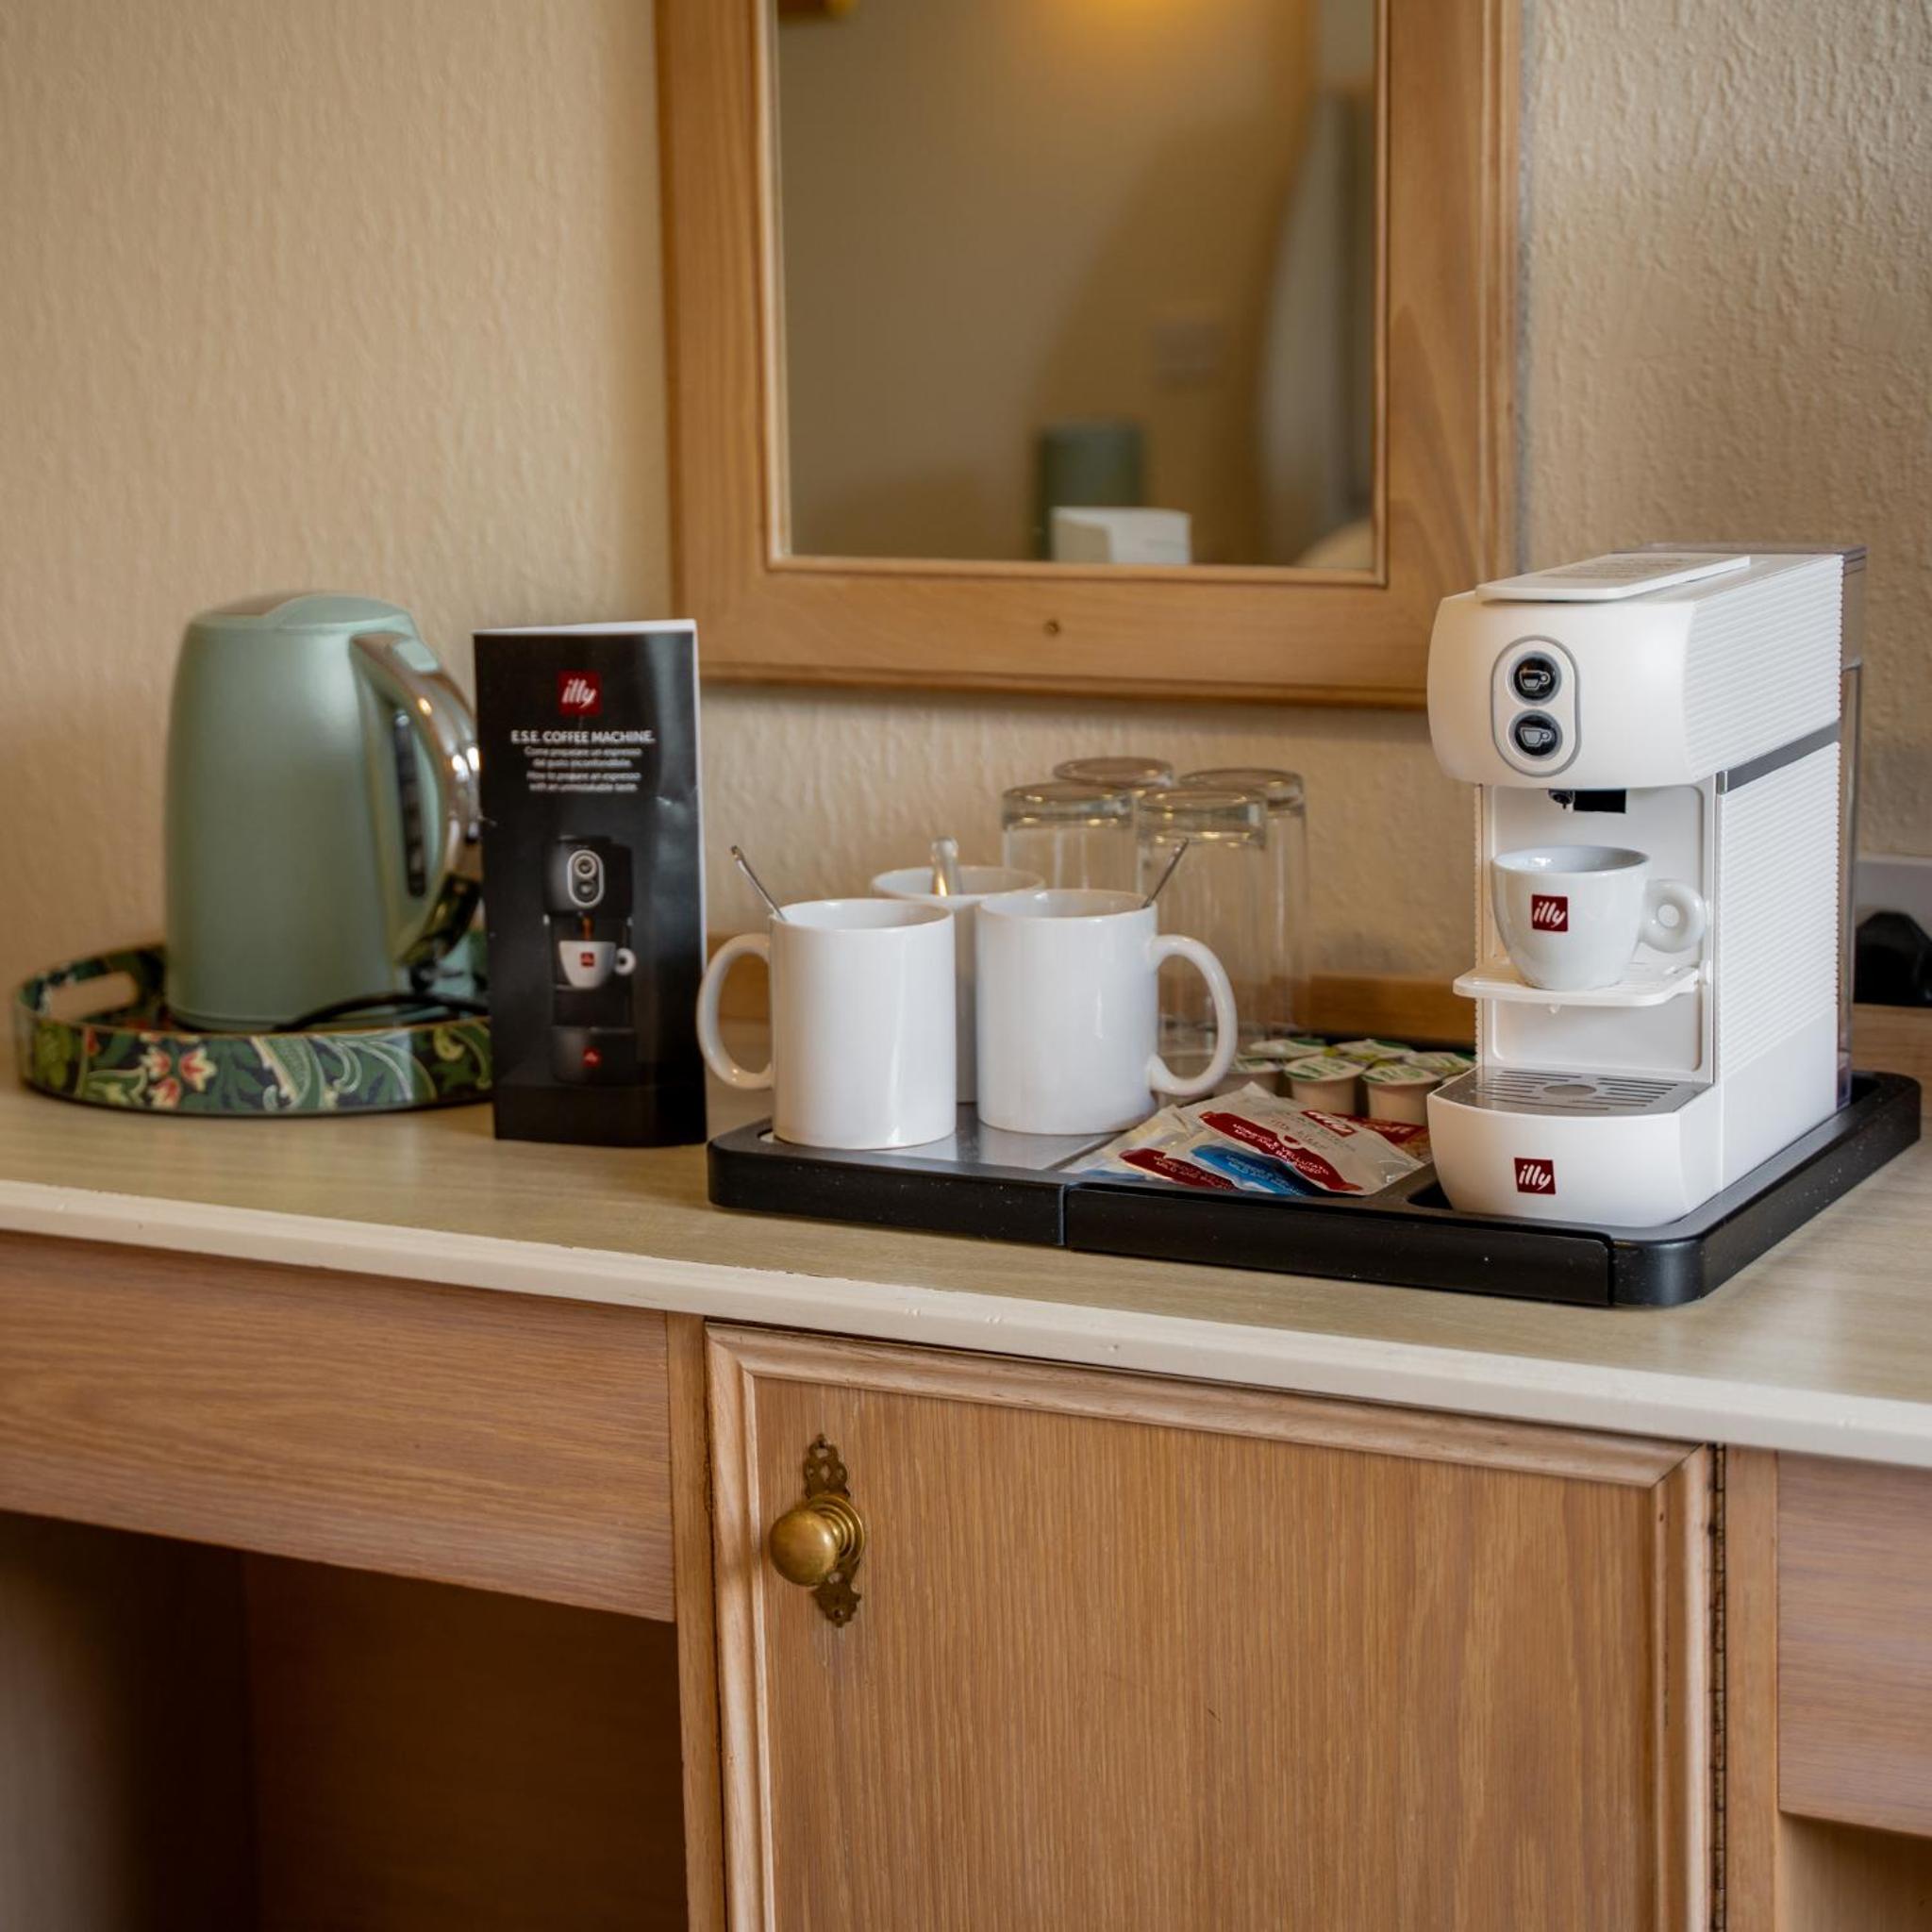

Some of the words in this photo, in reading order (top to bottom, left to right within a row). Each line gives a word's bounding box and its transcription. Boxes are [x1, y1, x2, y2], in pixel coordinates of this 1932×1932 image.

[561, 678, 597, 708] illy
[542, 730, 590, 743] COFFEE
[1534, 901, 1566, 928] illy
[1519, 1163, 1552, 1191] illy
